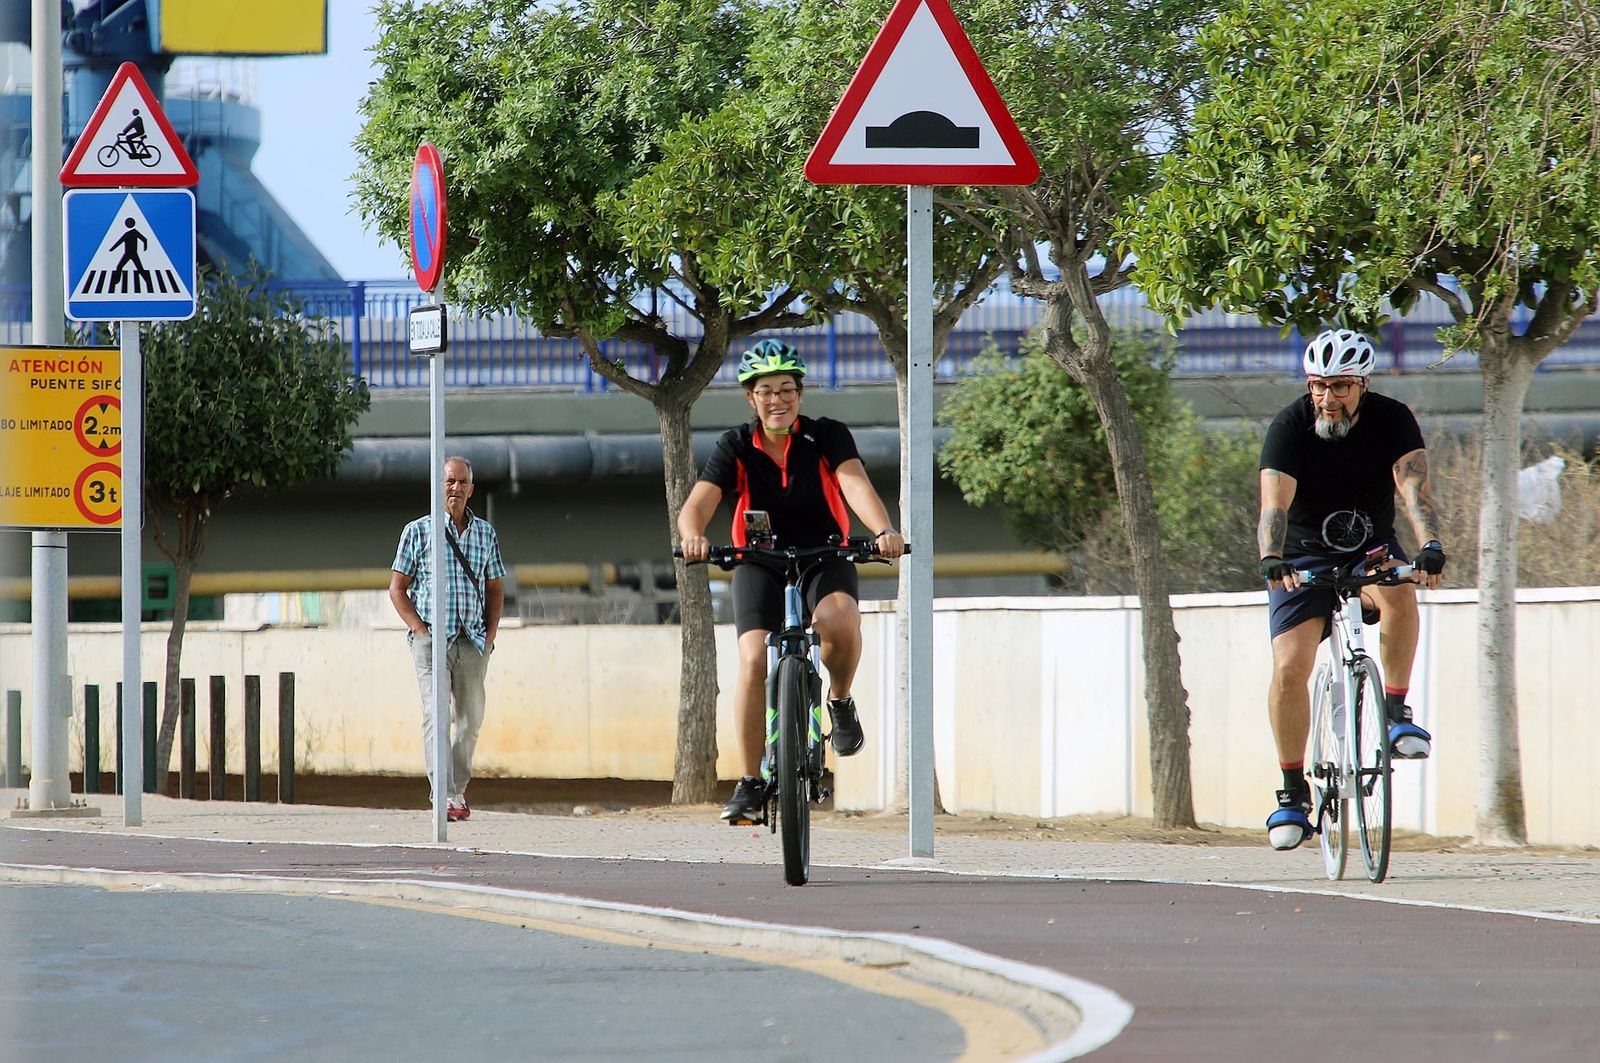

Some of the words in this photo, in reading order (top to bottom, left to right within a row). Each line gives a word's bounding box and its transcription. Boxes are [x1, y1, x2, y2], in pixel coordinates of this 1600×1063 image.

[9, 356, 103, 373] ATENCIÓN
[31, 379, 85, 390] PUENTE
[20, 419, 73, 431] LIMITADO
[24, 487, 71, 498] LIMITADO
